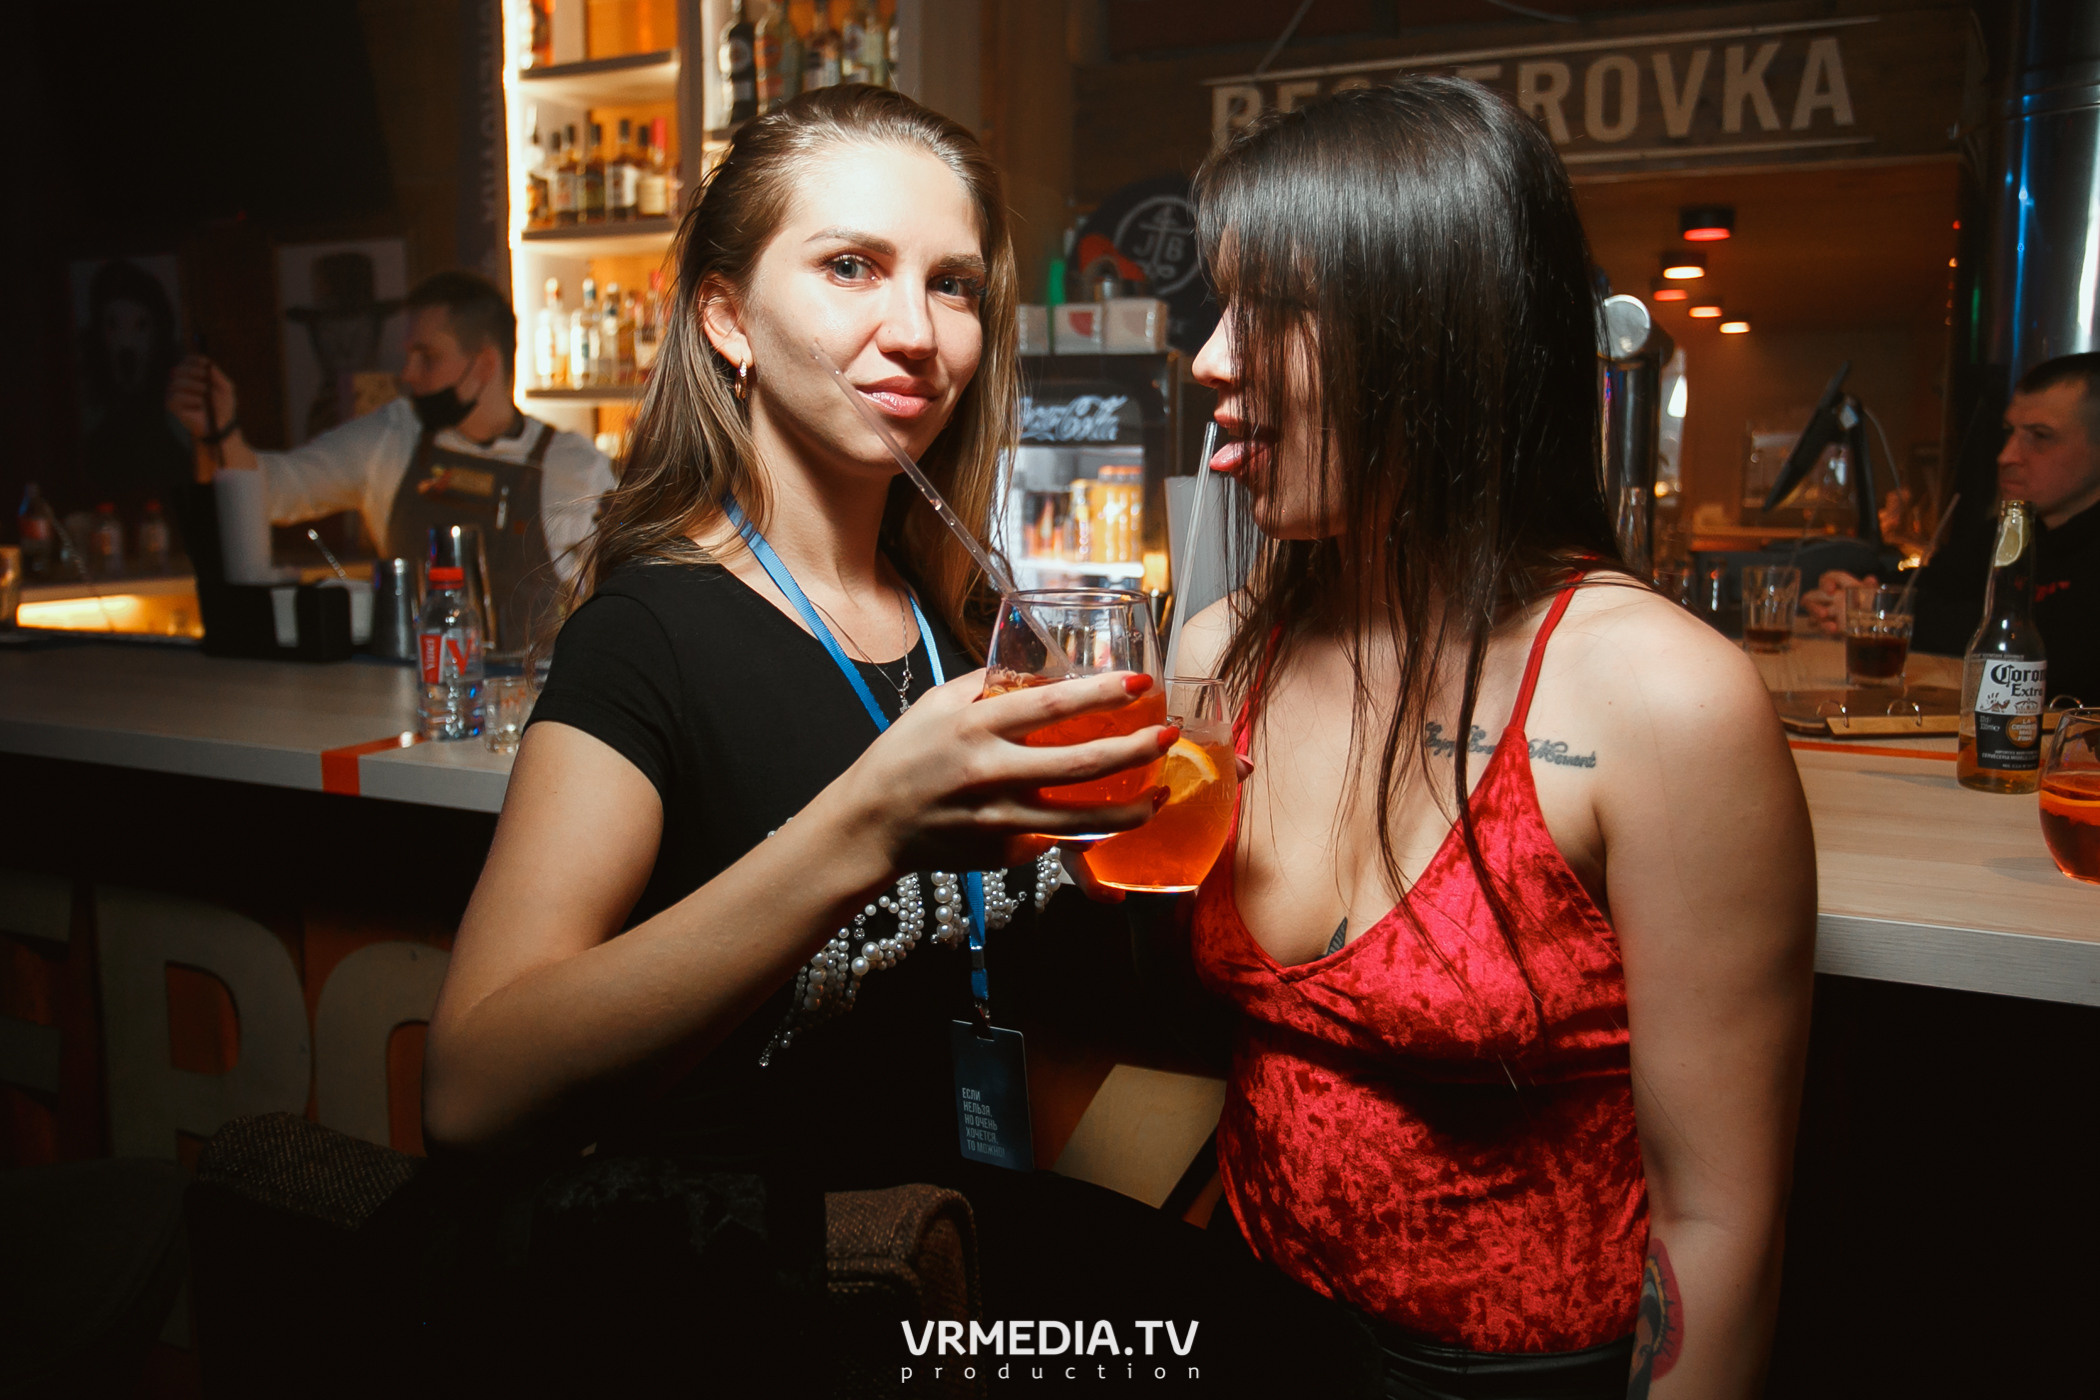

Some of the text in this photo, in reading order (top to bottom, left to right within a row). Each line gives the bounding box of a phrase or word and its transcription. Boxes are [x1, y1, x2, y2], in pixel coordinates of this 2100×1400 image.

[1211, 37, 1857, 156] BROVKA
[962, 1087, 981, 1101] ЕСЛИ
[964, 1113, 998, 1131] НО ОЧЕНЬ
[967, 1139, 1005, 1158] ТО МОЖНО!
